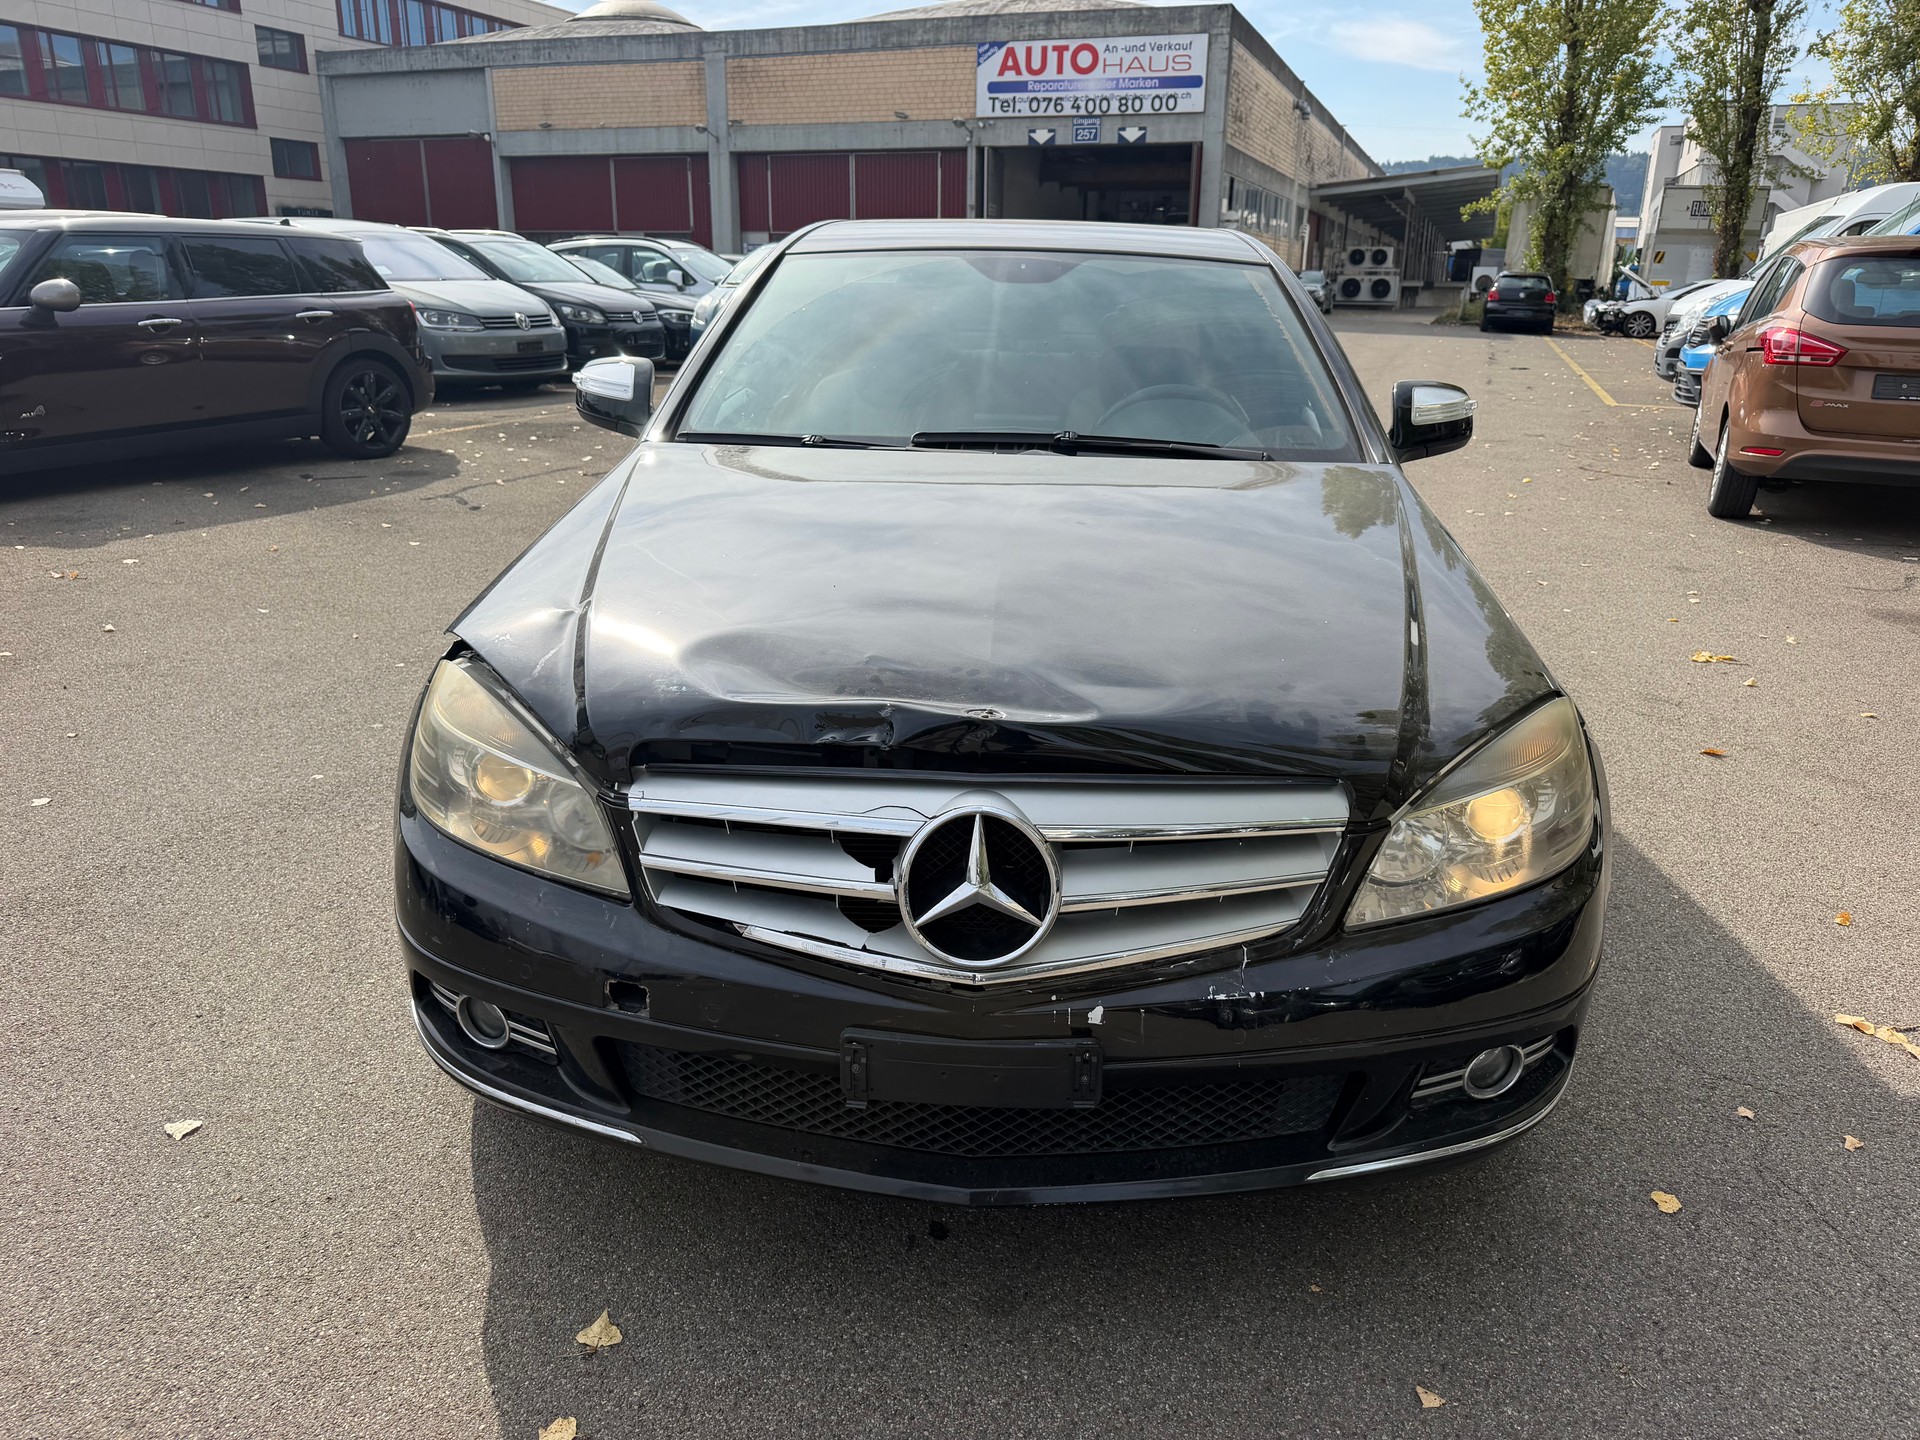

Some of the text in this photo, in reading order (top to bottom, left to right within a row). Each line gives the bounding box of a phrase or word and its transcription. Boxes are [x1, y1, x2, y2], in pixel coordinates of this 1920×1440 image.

[1103, 43, 1118, 54] An
[1149, 40, 1193, 51] Verkauf
[997, 43, 1099, 77] AUTO
[1102, 54, 1192, 74] HAUS
[1027, 80, 1089, 93] Reparature
[1118, 77, 1159, 89] Marken
[988, 95, 1177, 115] Tel. 076 400 80 00
[1076, 129, 1096, 140] 257
